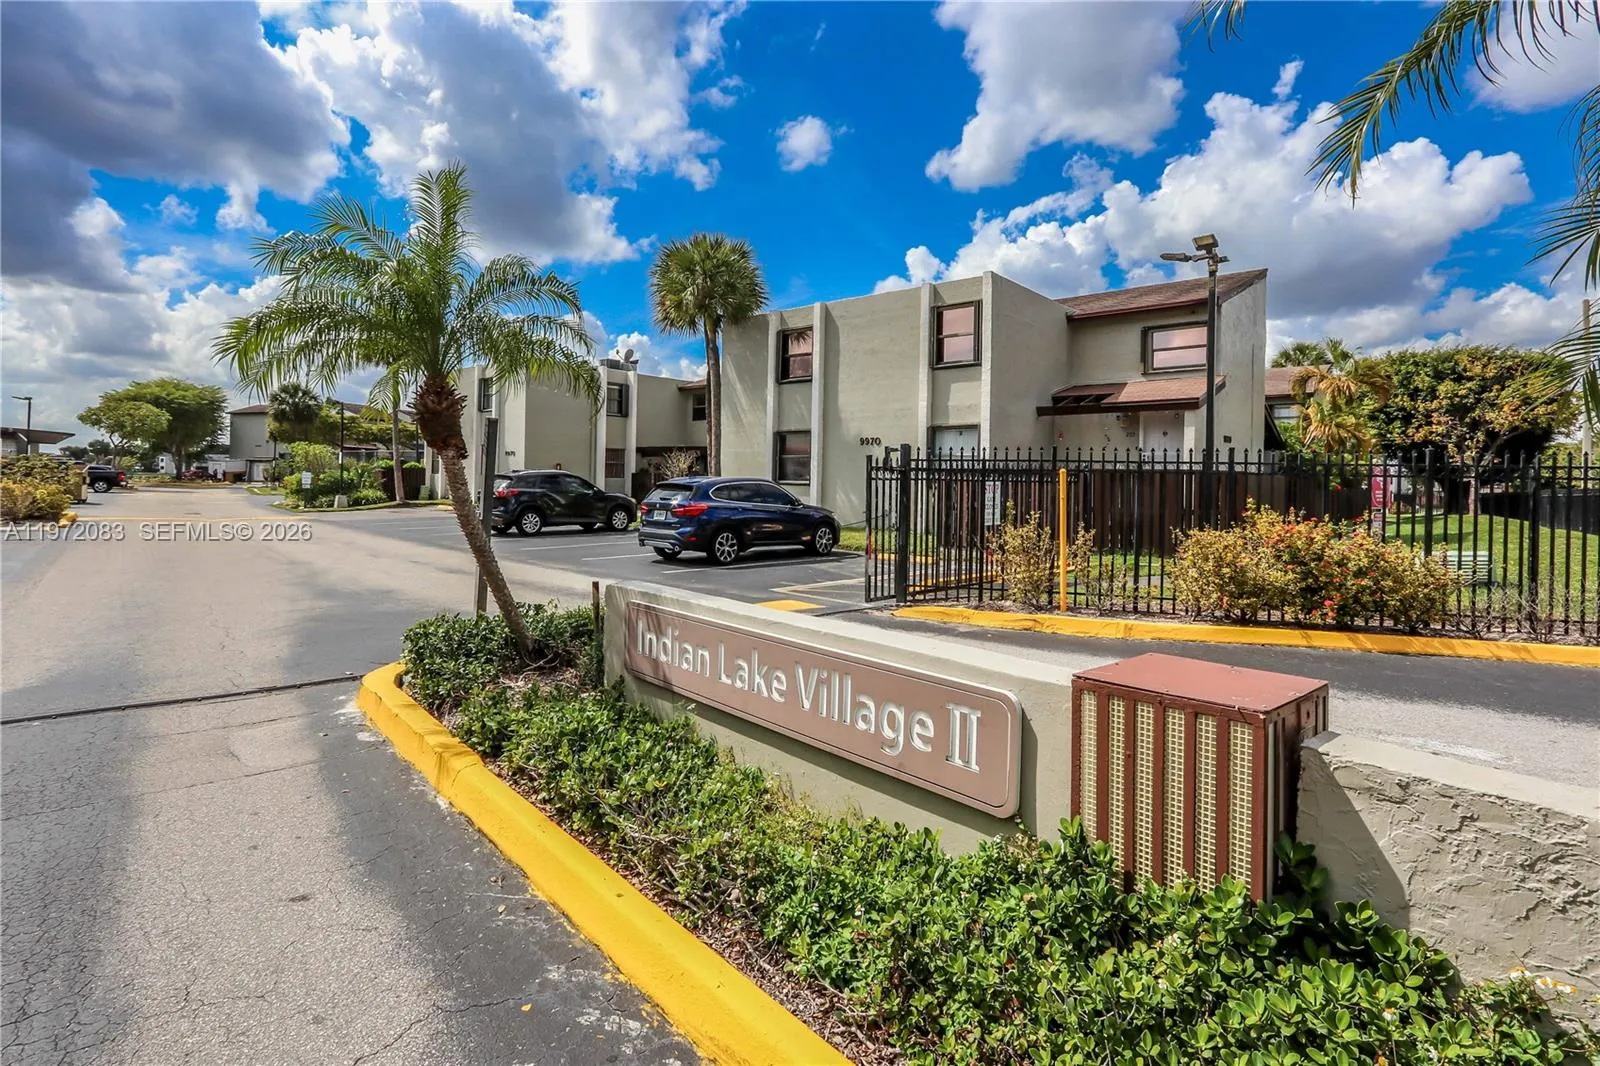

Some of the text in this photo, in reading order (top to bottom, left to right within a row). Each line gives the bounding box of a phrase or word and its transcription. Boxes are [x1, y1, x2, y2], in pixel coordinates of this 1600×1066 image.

[859, 437, 881, 446] 9970
[636, 619, 982, 773] Indian Lake Village II
